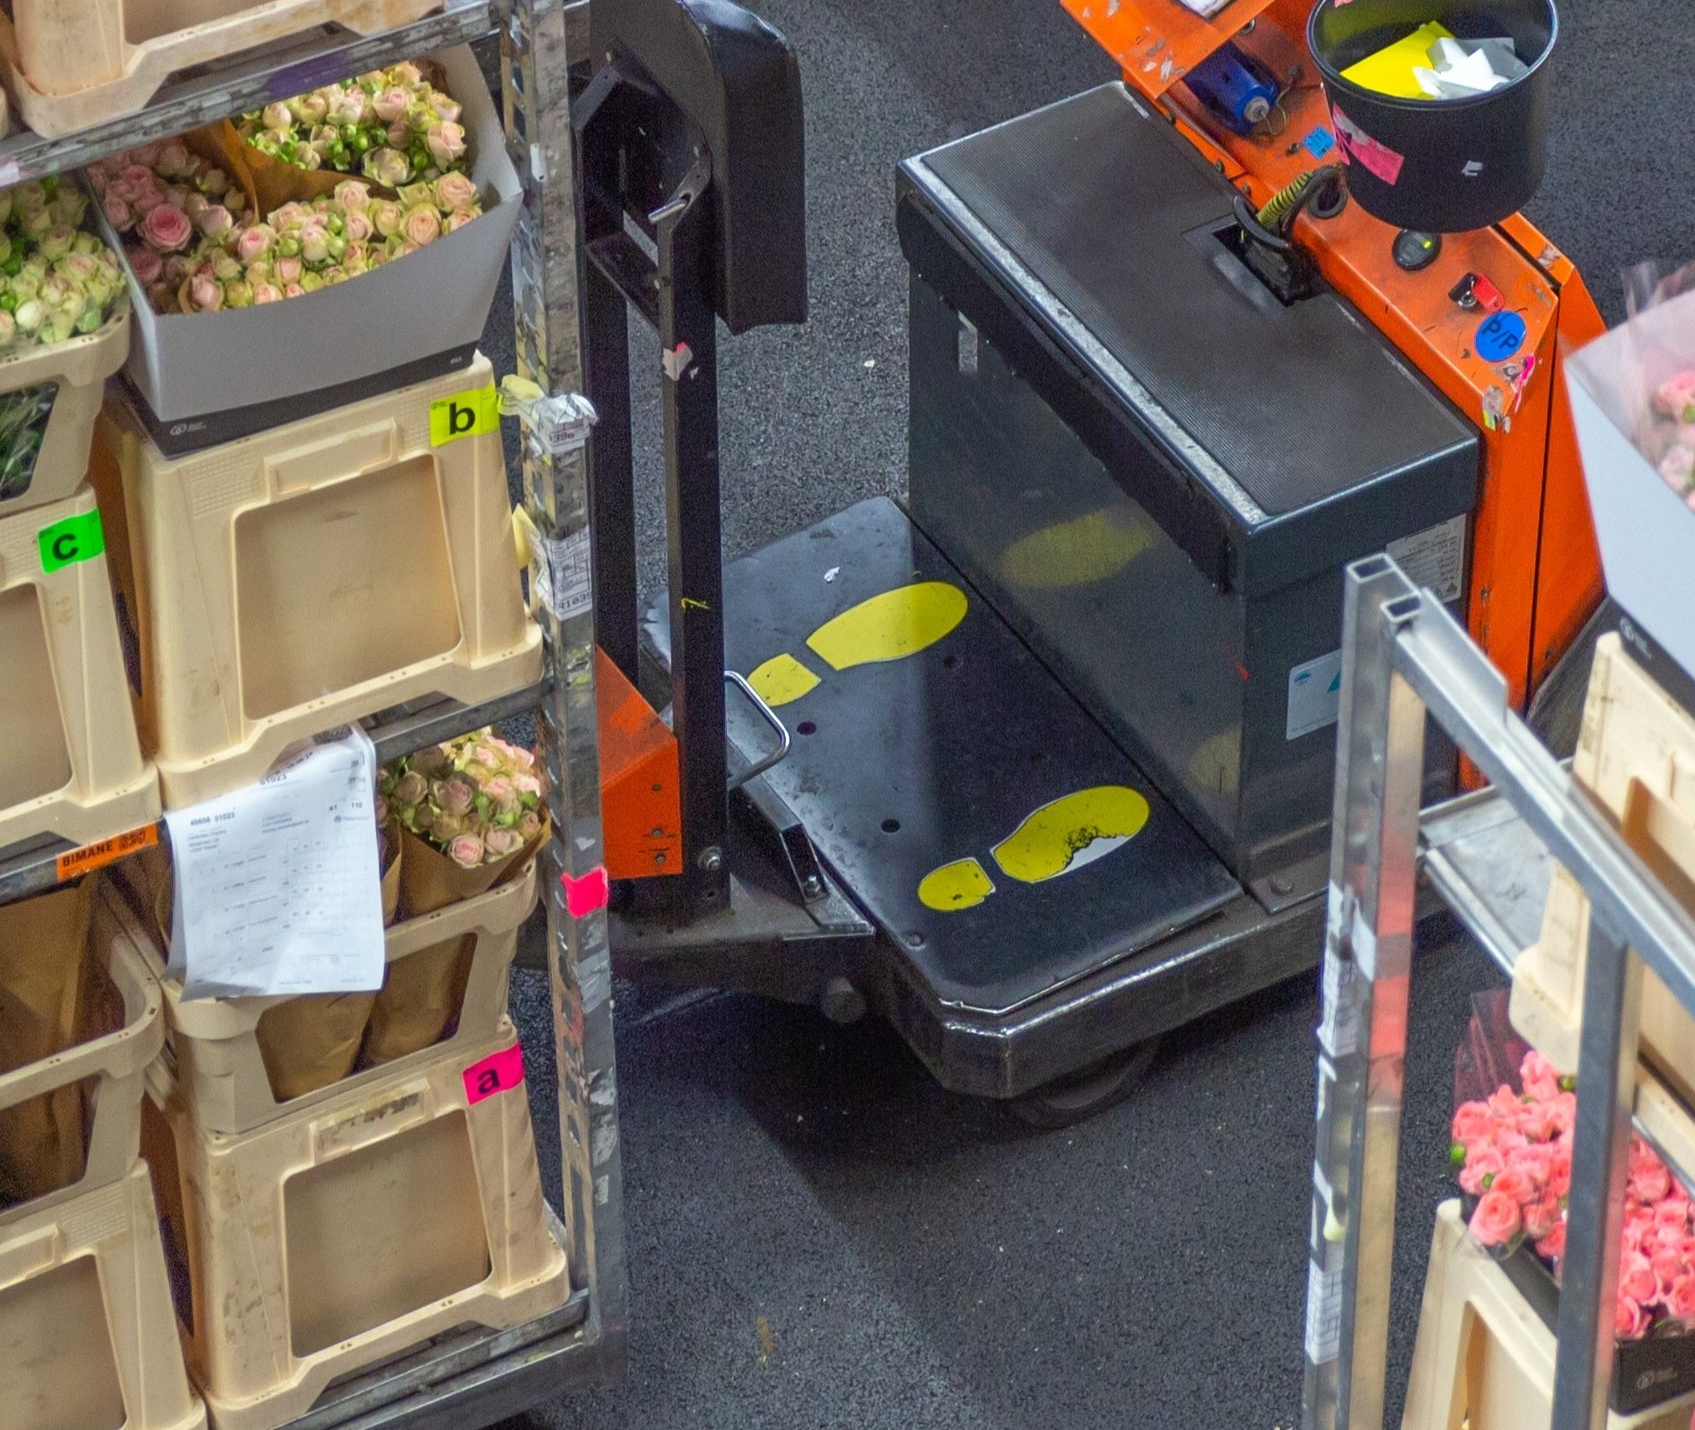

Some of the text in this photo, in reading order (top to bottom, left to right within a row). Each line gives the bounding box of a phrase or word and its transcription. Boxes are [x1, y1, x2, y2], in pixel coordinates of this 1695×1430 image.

[1481, 319, 1519, 349] P/P
[449, 401, 476, 435] b
[62, 840, 113, 867] BIMANE
[476, 1068, 501, 1095] a
